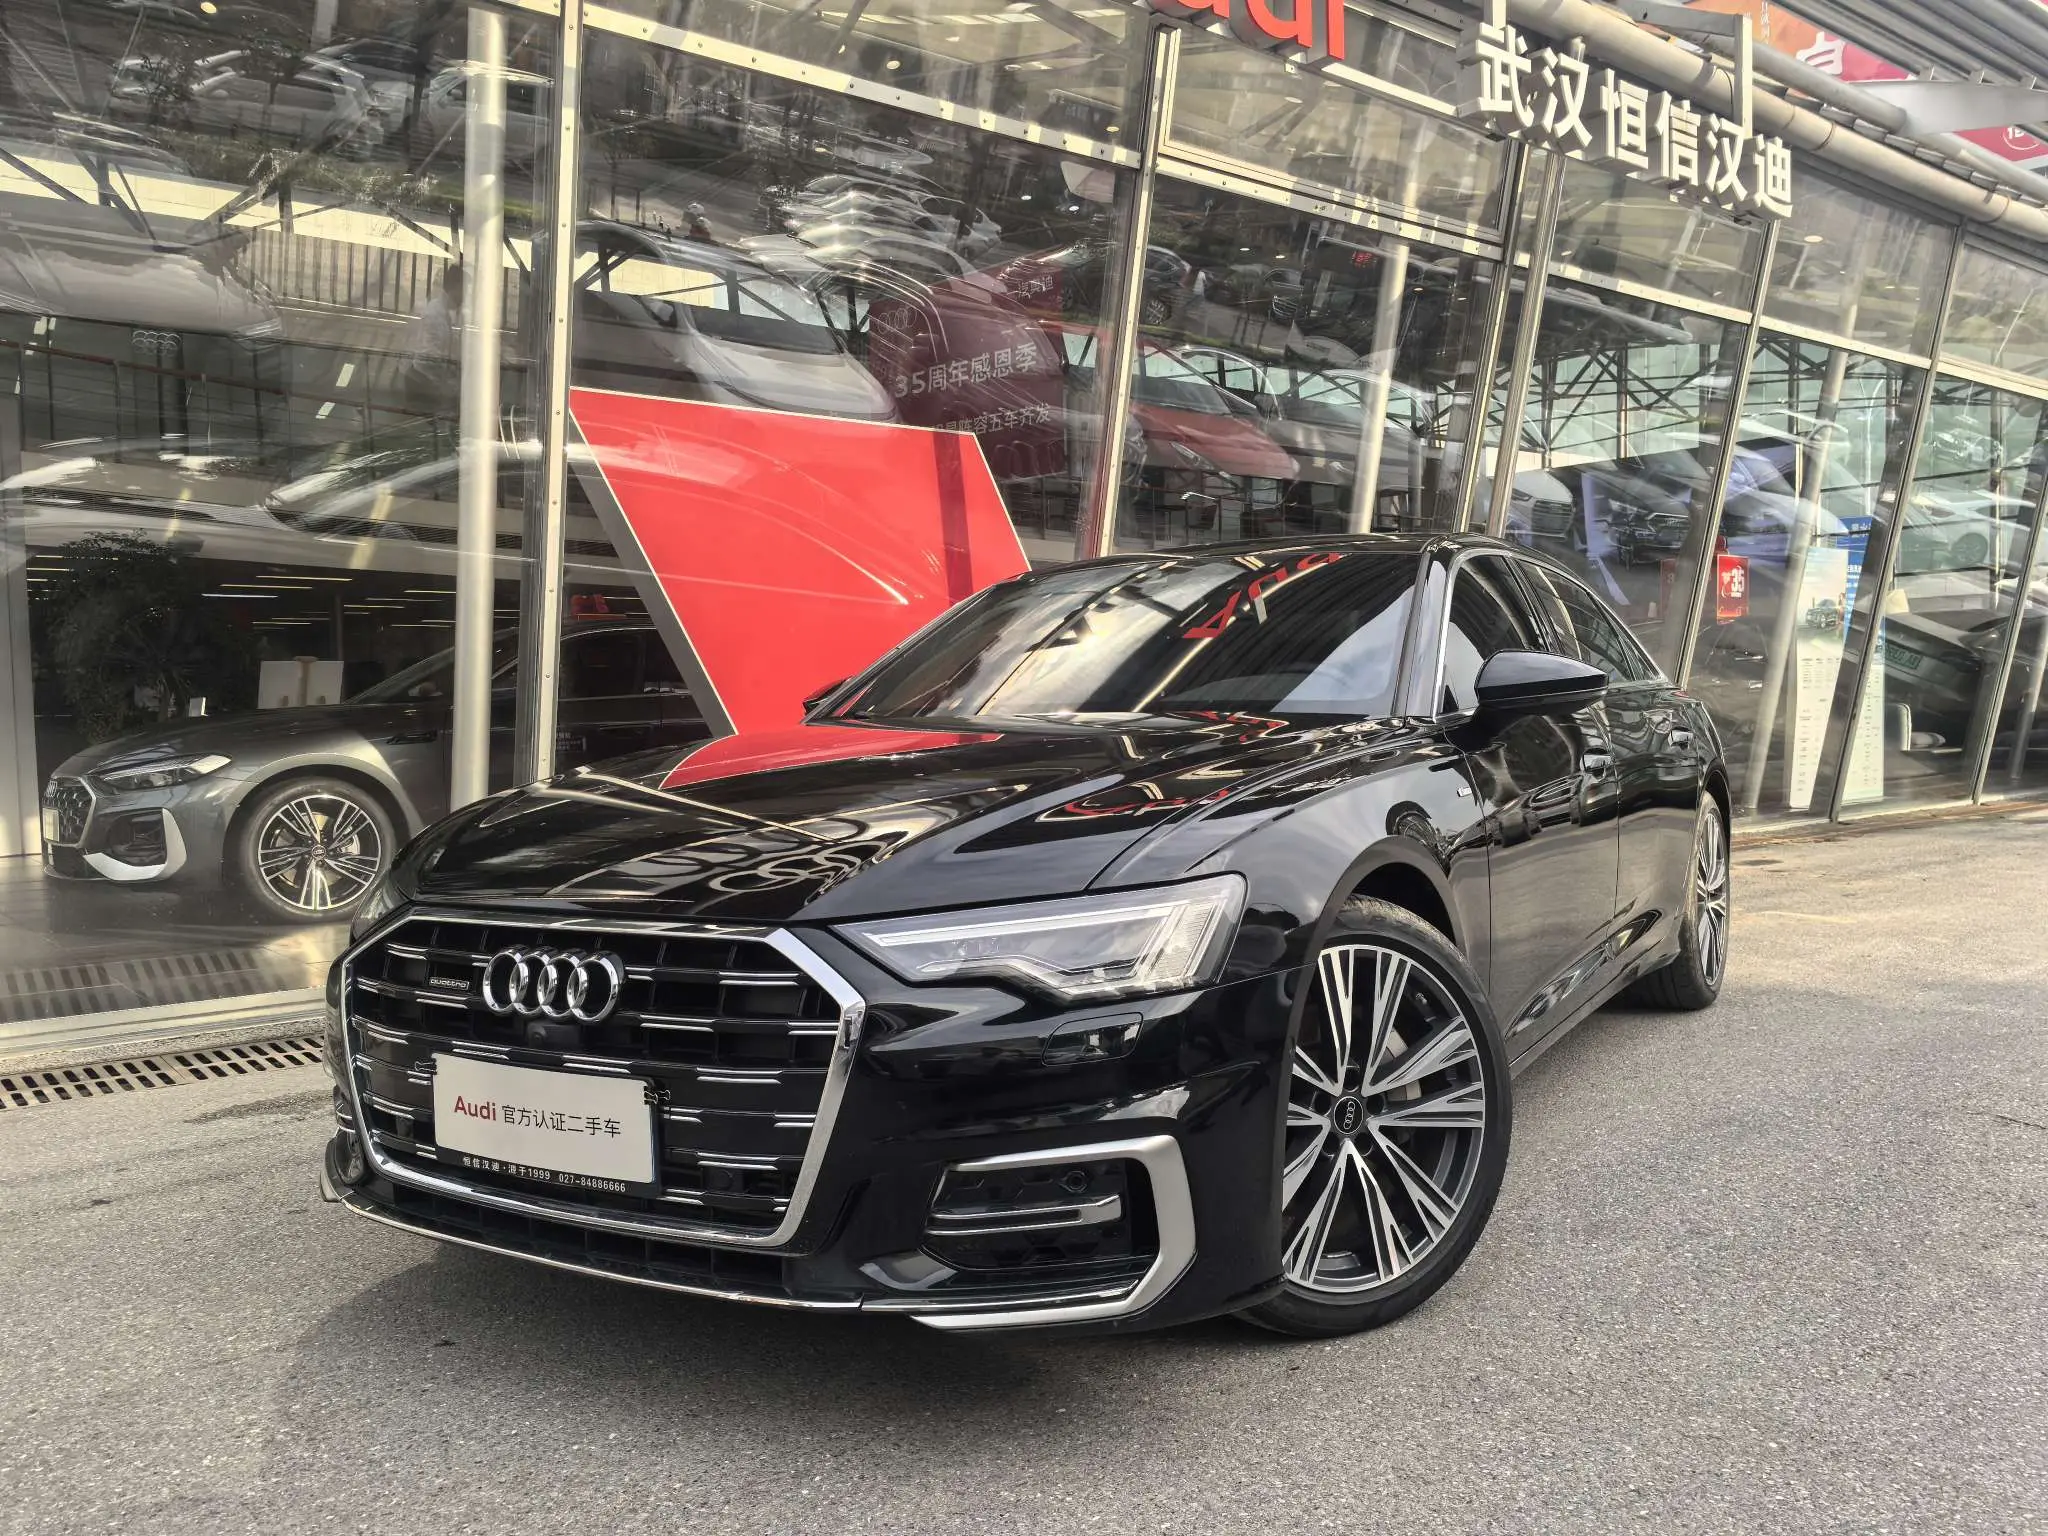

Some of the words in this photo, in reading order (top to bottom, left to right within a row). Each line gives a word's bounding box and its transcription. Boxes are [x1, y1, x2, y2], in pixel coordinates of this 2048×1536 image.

[1475, 22, 1793, 218] 武汉恒信汉迪
[895, 341, 1038, 398] 35周年感恩季
[430, 979, 467, 988] quattro
[454, 1095, 497, 1121] Audi
[501, 1104, 622, 1139] 官方认证二手车
[558, 1173, 626, 1193] 027-84886666
